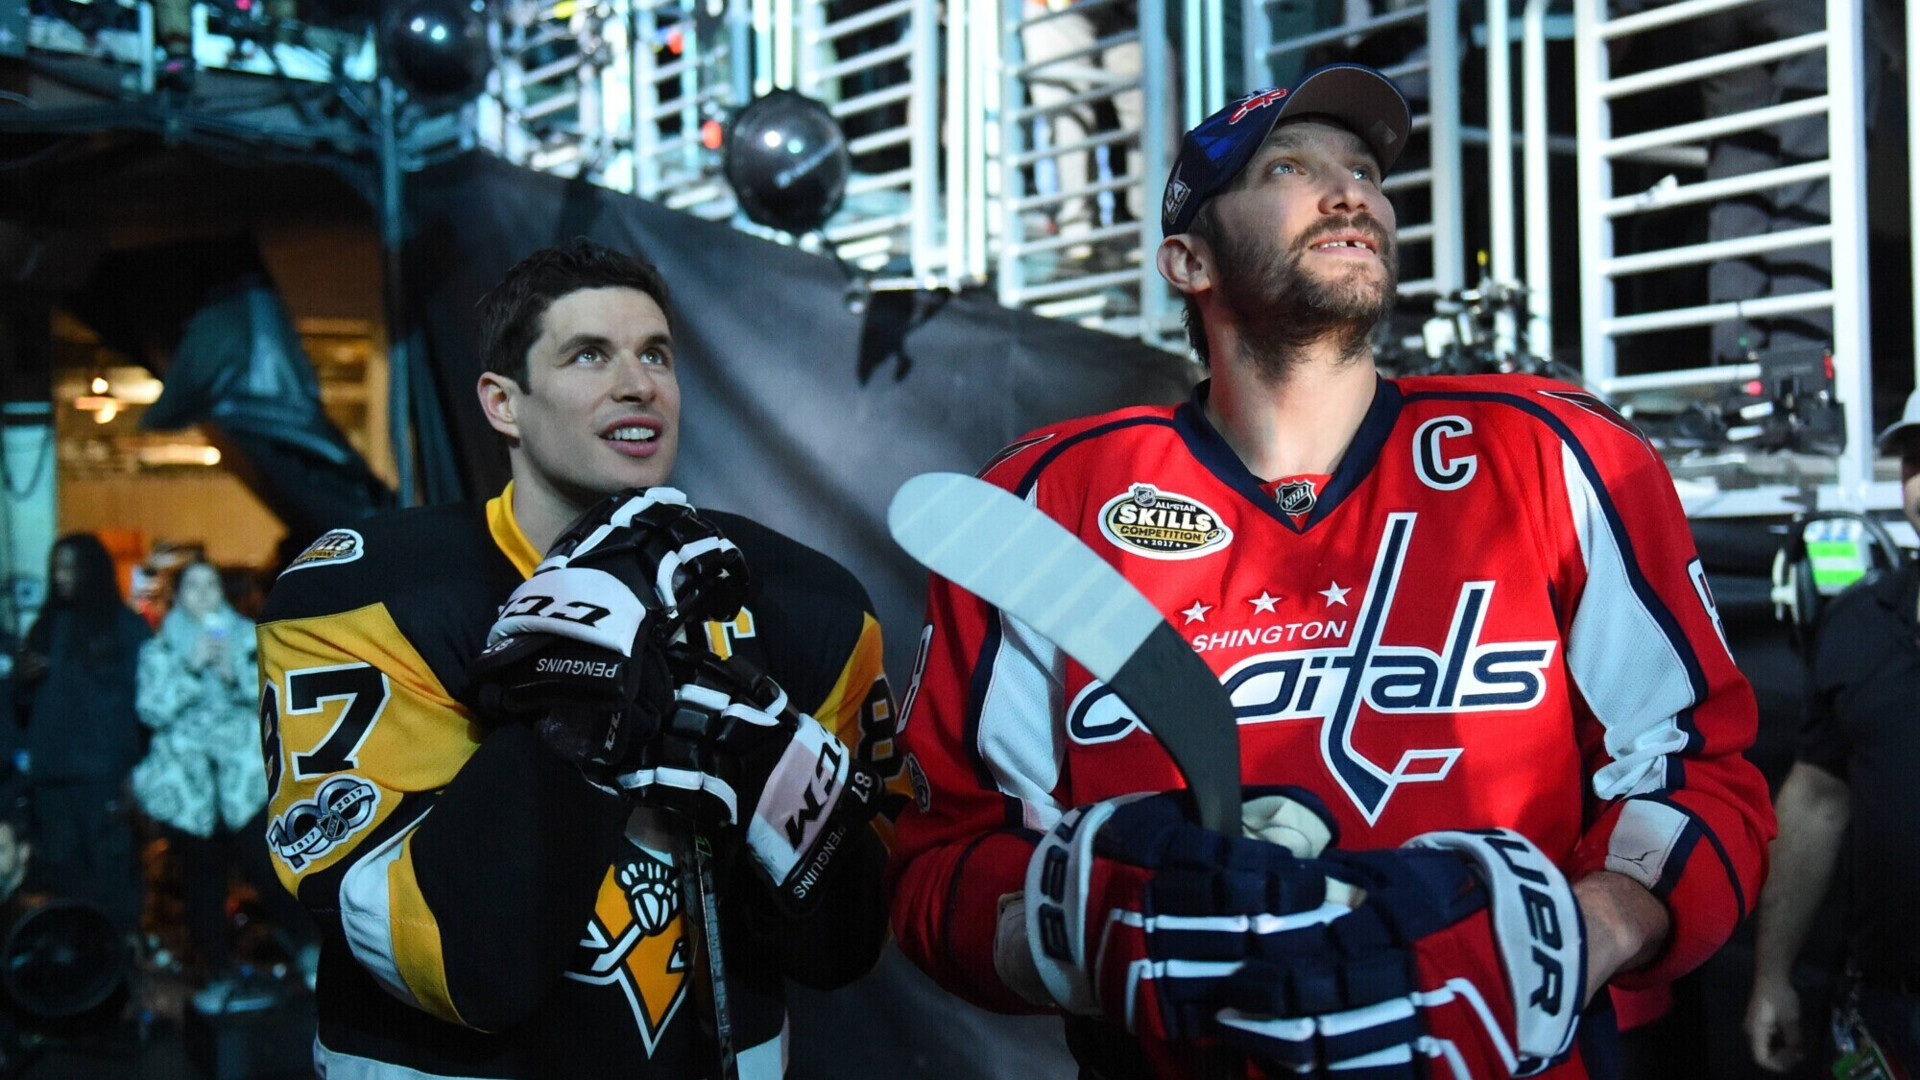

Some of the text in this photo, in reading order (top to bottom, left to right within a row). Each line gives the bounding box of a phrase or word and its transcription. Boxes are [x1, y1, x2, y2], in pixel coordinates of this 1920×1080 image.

[1412, 415, 1477, 491] C
[1284, 483, 1308, 509] NHL
[1118, 503, 1212, 532] SKILLS
[1120, 525, 1201, 542] COMPETITION
[1151, 539, 1174, 548] 2017
[1191, 620, 1348, 654] SHINGTON
[535, 657, 620, 680] PENGUINS
[258, 661, 391, 806] 87
[337, 787, 364, 811] 2017
[783, 727, 843, 854] CM
[851, 771, 874, 804] 87
[290, 832, 318, 854] 1917
[1038, 805, 1095, 967] BAU
[1489, 829, 1565, 1017] UER
